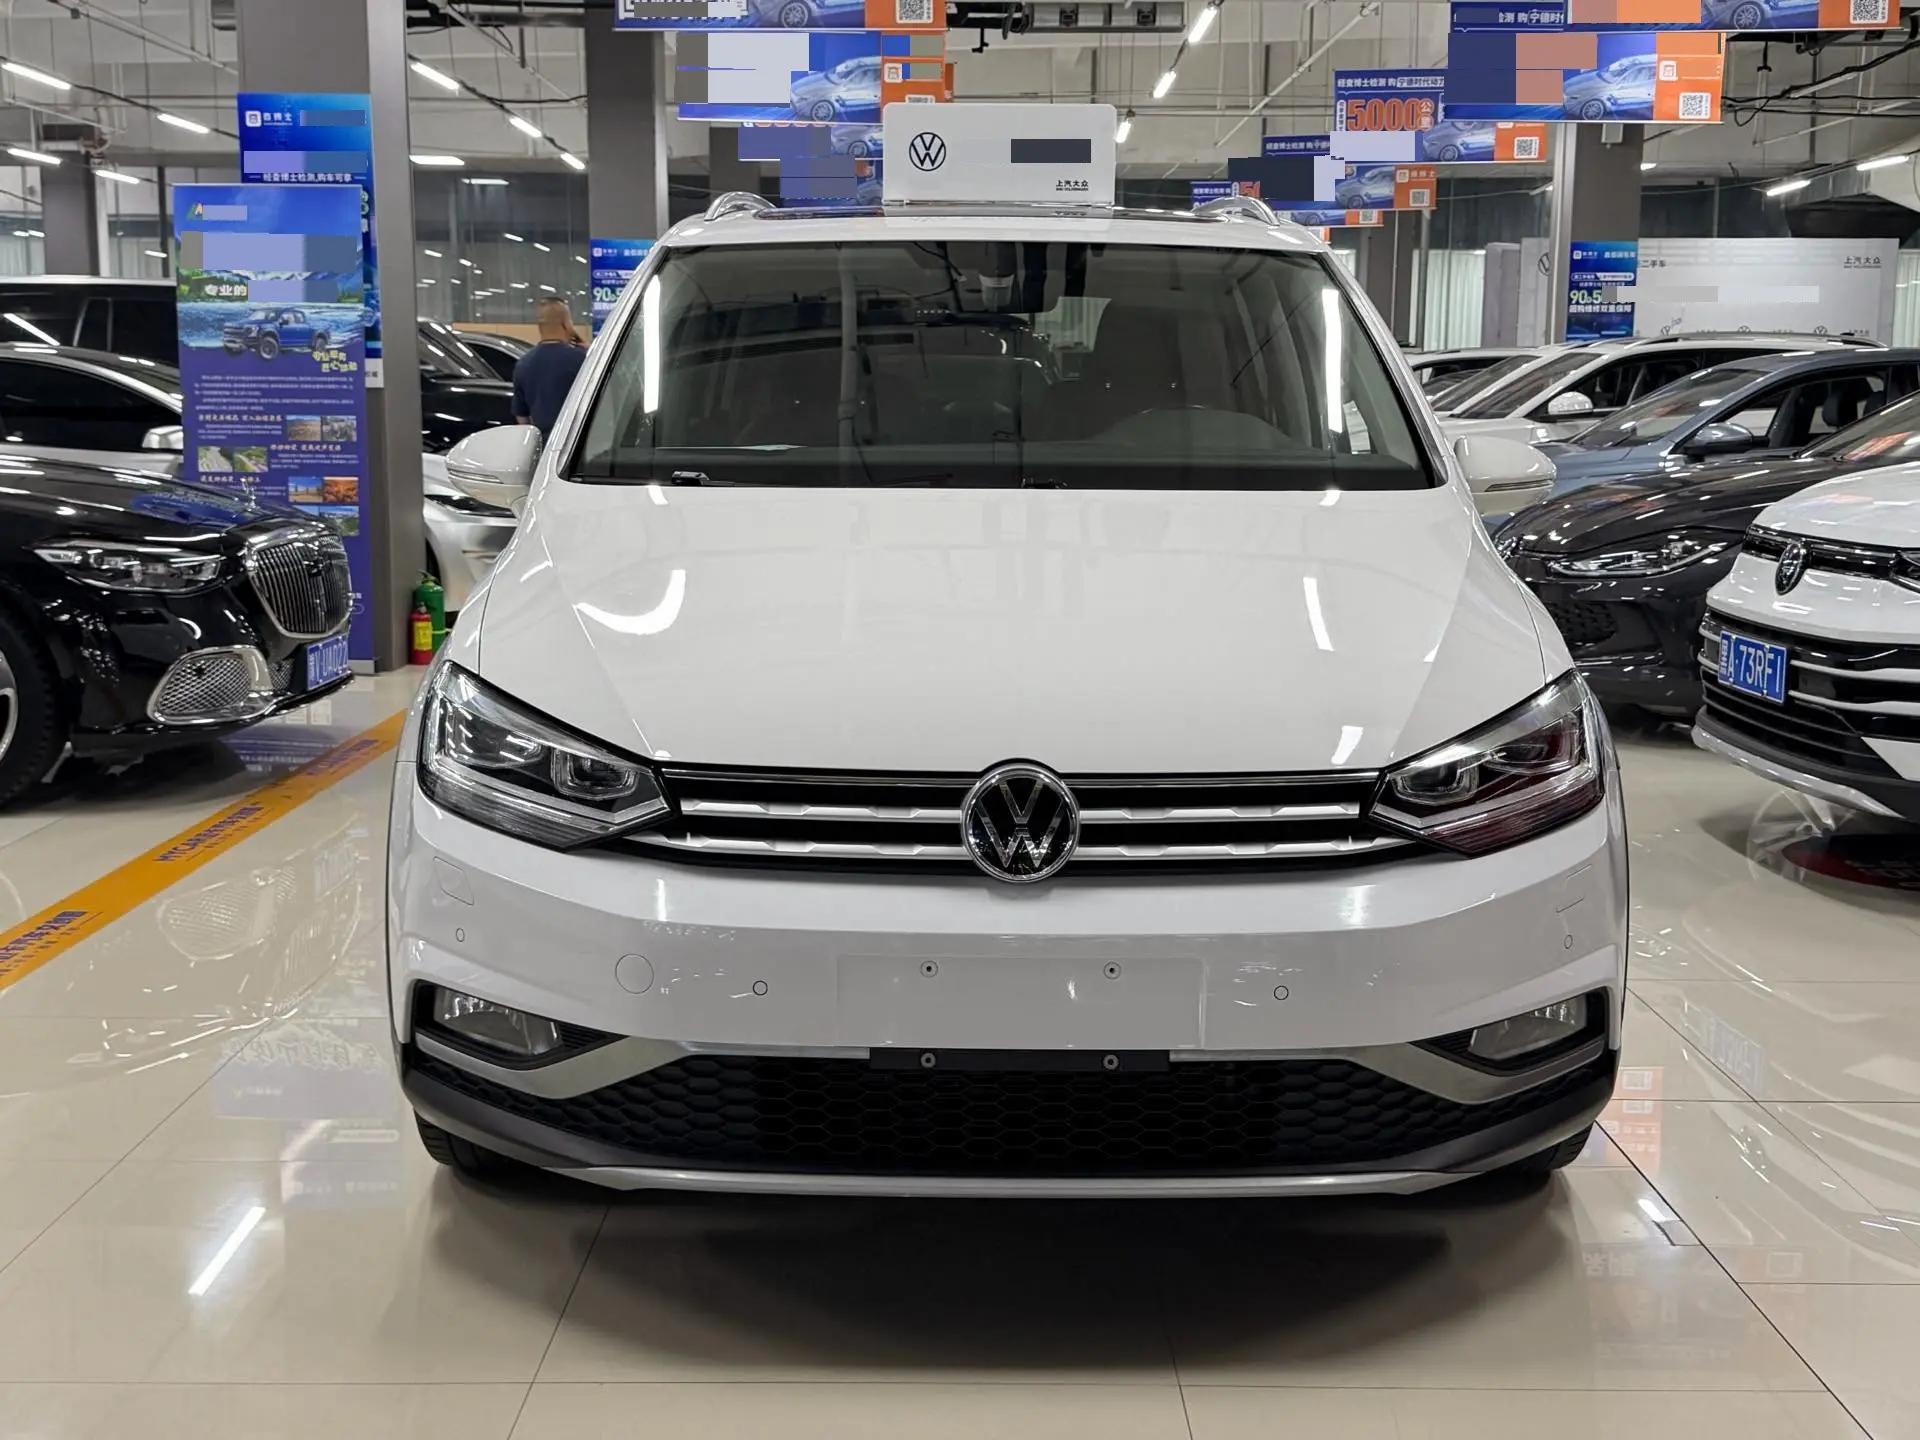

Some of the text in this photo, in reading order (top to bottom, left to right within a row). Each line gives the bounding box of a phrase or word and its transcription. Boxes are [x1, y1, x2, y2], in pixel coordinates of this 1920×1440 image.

[1347, 98, 1421, 131] 5000
[1055, 179, 1089, 187] 上汽大众
[1843, 255, 1881, 265] 上汽大众
